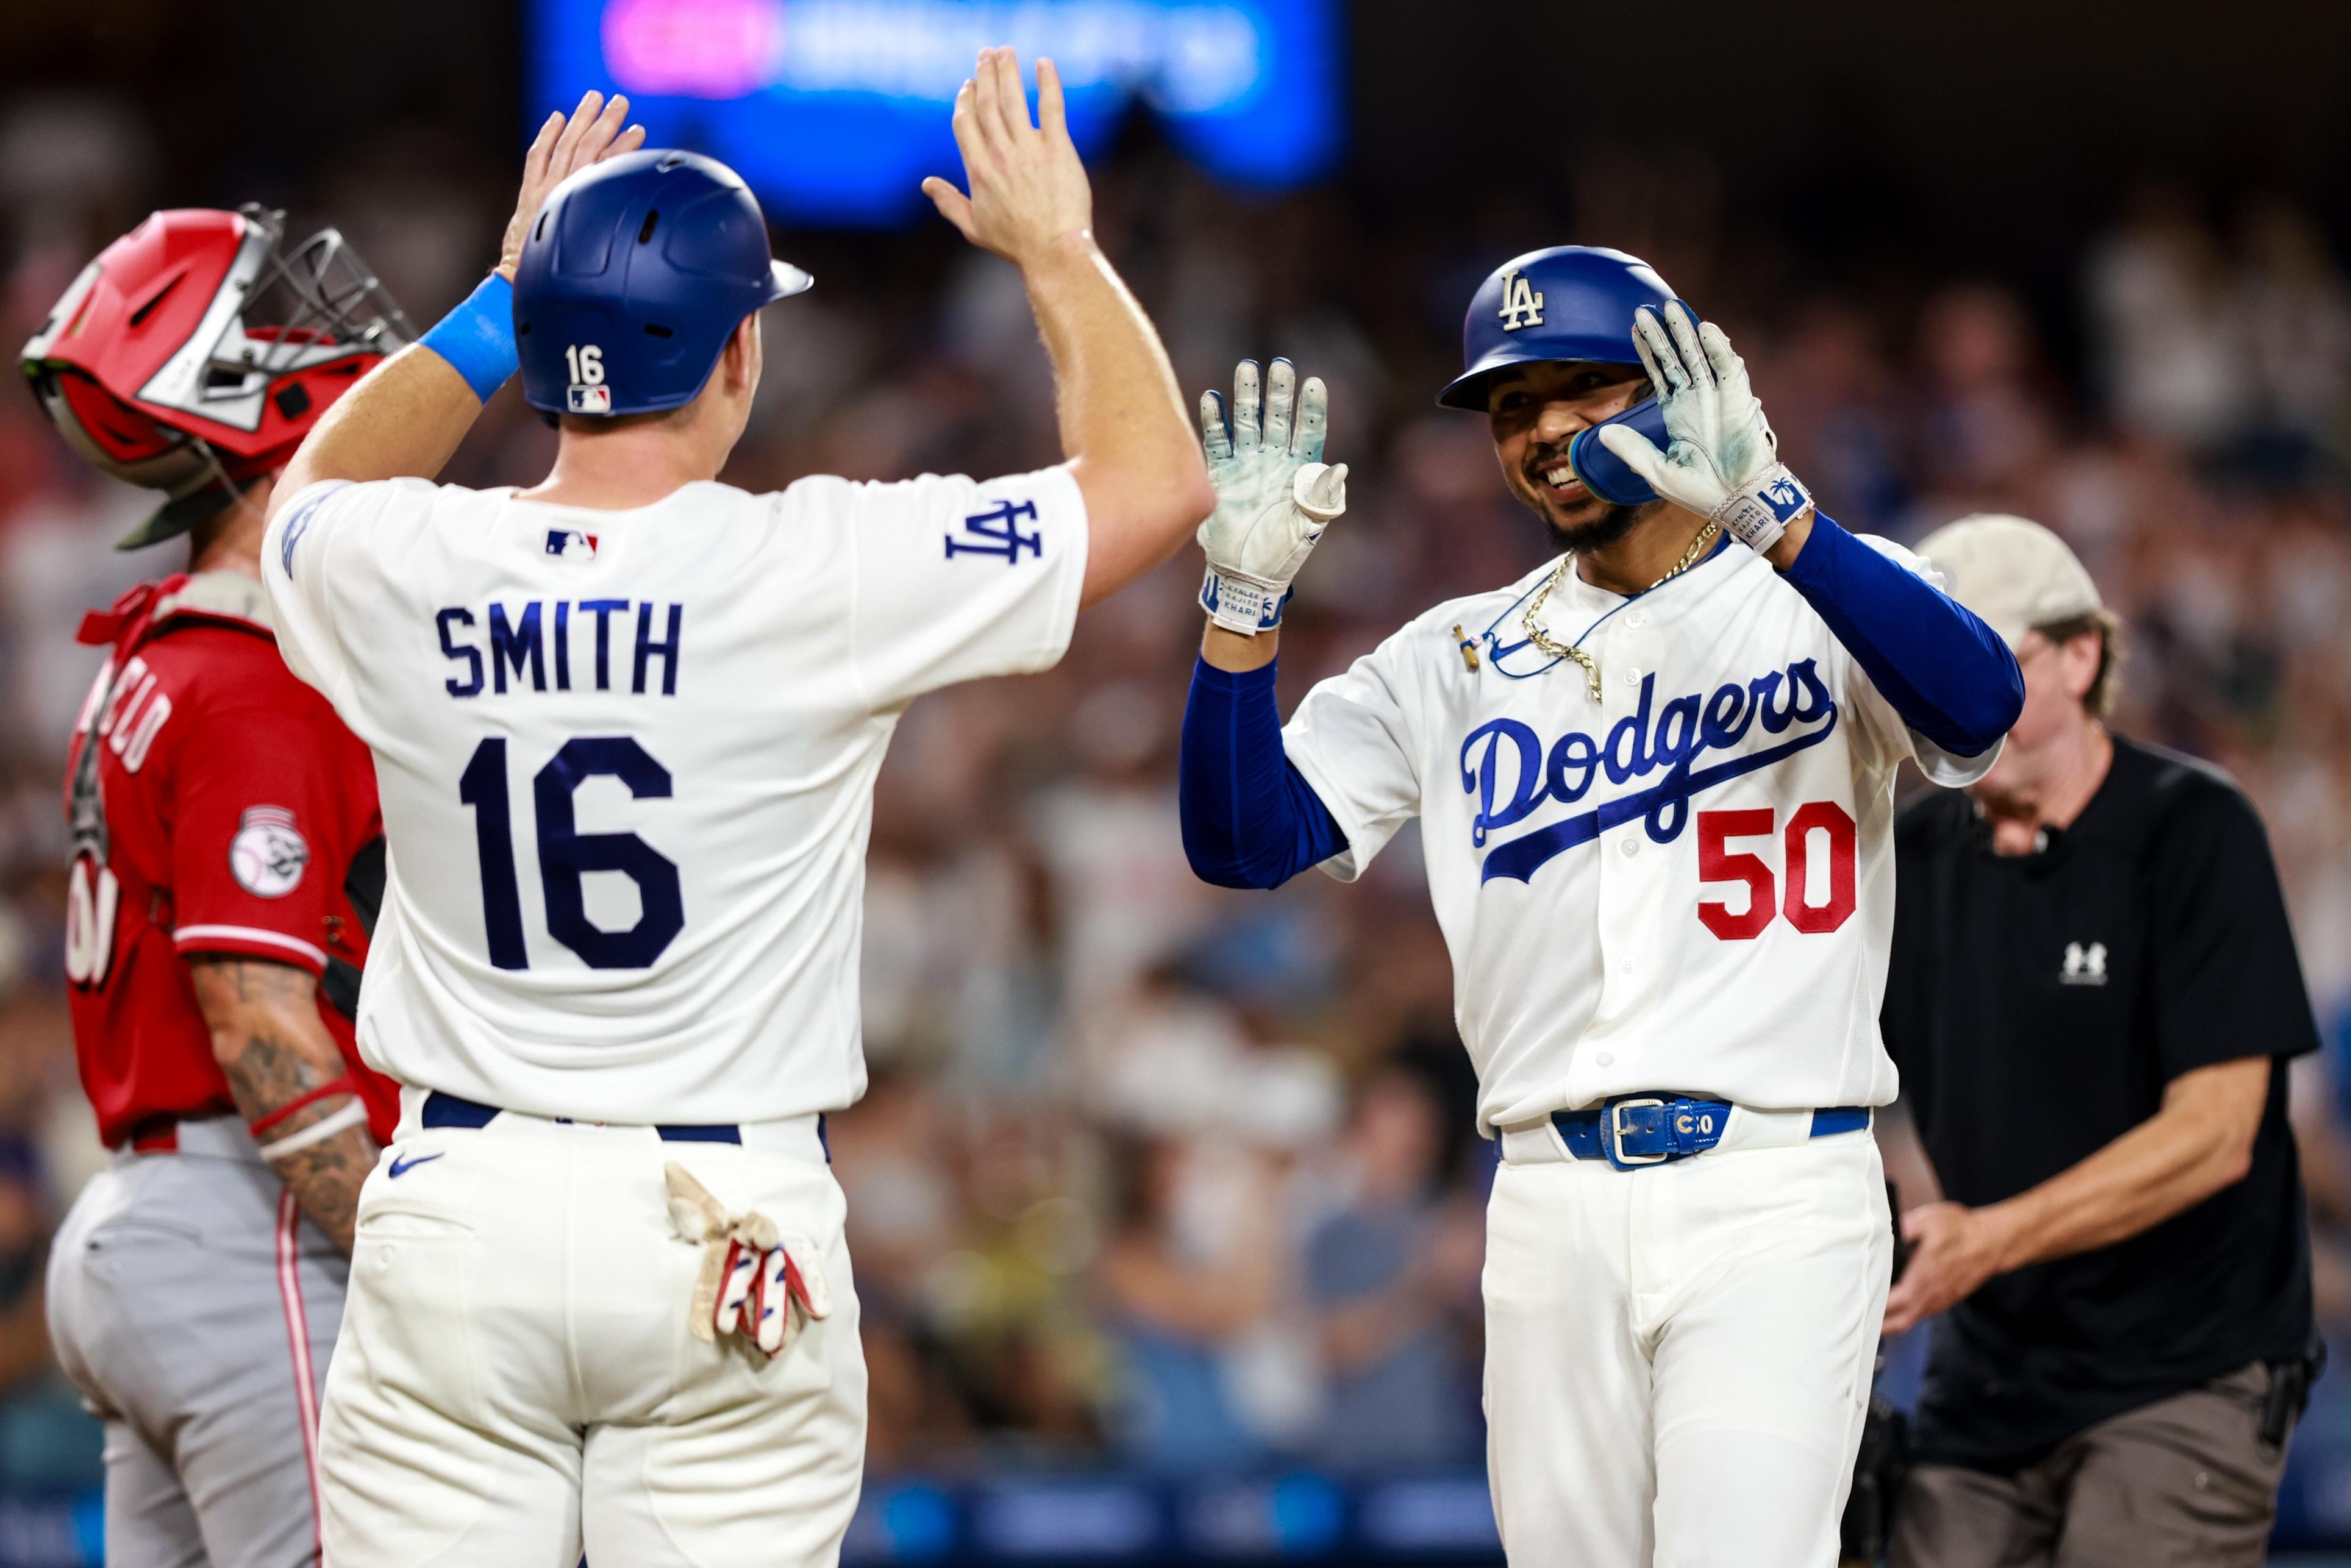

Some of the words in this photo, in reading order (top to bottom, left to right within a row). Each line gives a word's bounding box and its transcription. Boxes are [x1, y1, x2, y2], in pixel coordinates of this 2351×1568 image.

[1498, 269, 1544, 331] LA
[565, 344, 605, 385] 16
[944, 500, 1041, 565] LA
[1730, 505, 1755, 527] KYNLEE
[1745, 516, 1770, 540] KHARI
[1224, 601, 1257, 617] KHARI
[1225, 593, 1259, 607] KAJITO
[1227, 585, 1260, 600] KYNLEE
[435, 597, 683, 698] SMITH
[1460, 657, 1831, 848] Dodgers
[459, 736, 686, 971] 16
[1697, 800, 1857, 941] 50
